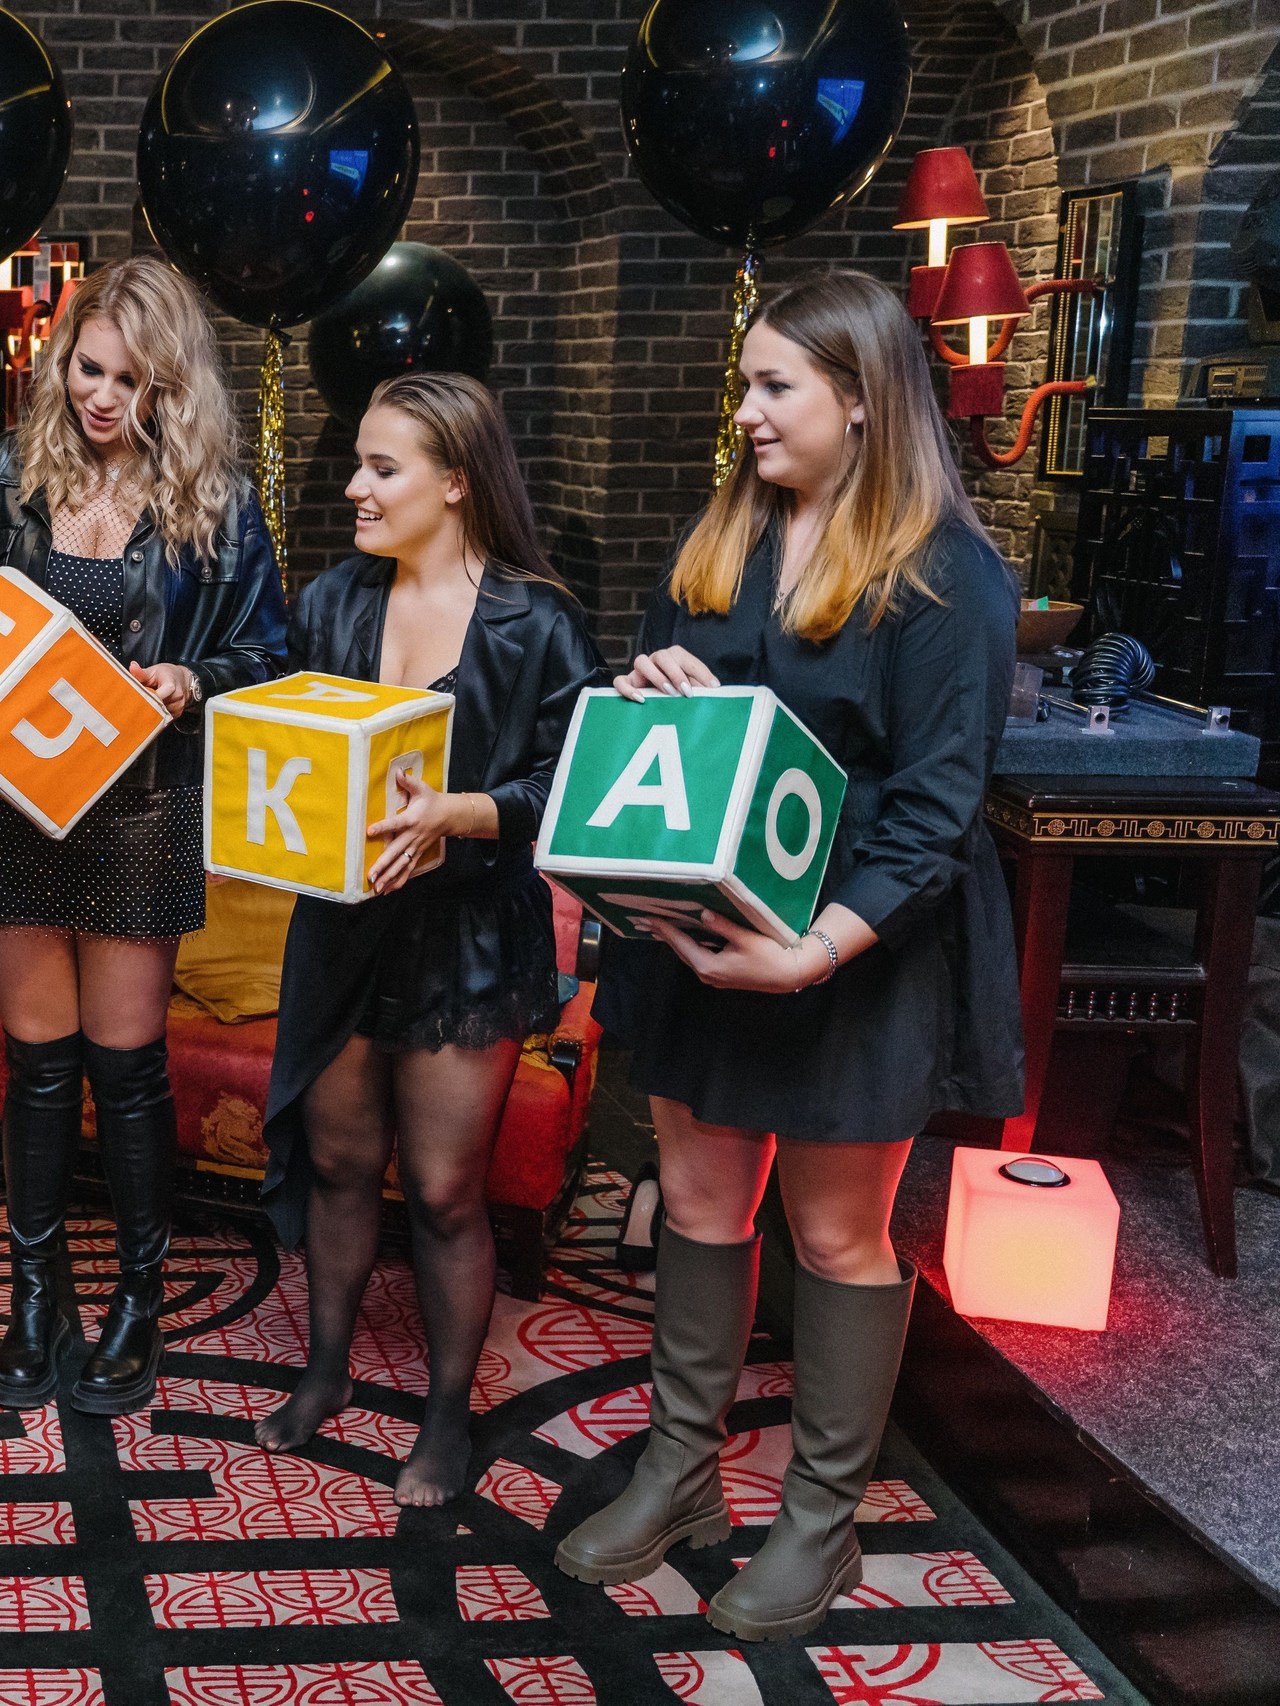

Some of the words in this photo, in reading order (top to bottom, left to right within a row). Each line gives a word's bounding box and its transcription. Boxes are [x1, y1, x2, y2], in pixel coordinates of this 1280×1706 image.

[247, 748, 311, 856] К
[586, 724, 690, 830] А
[765, 767, 822, 880] О
